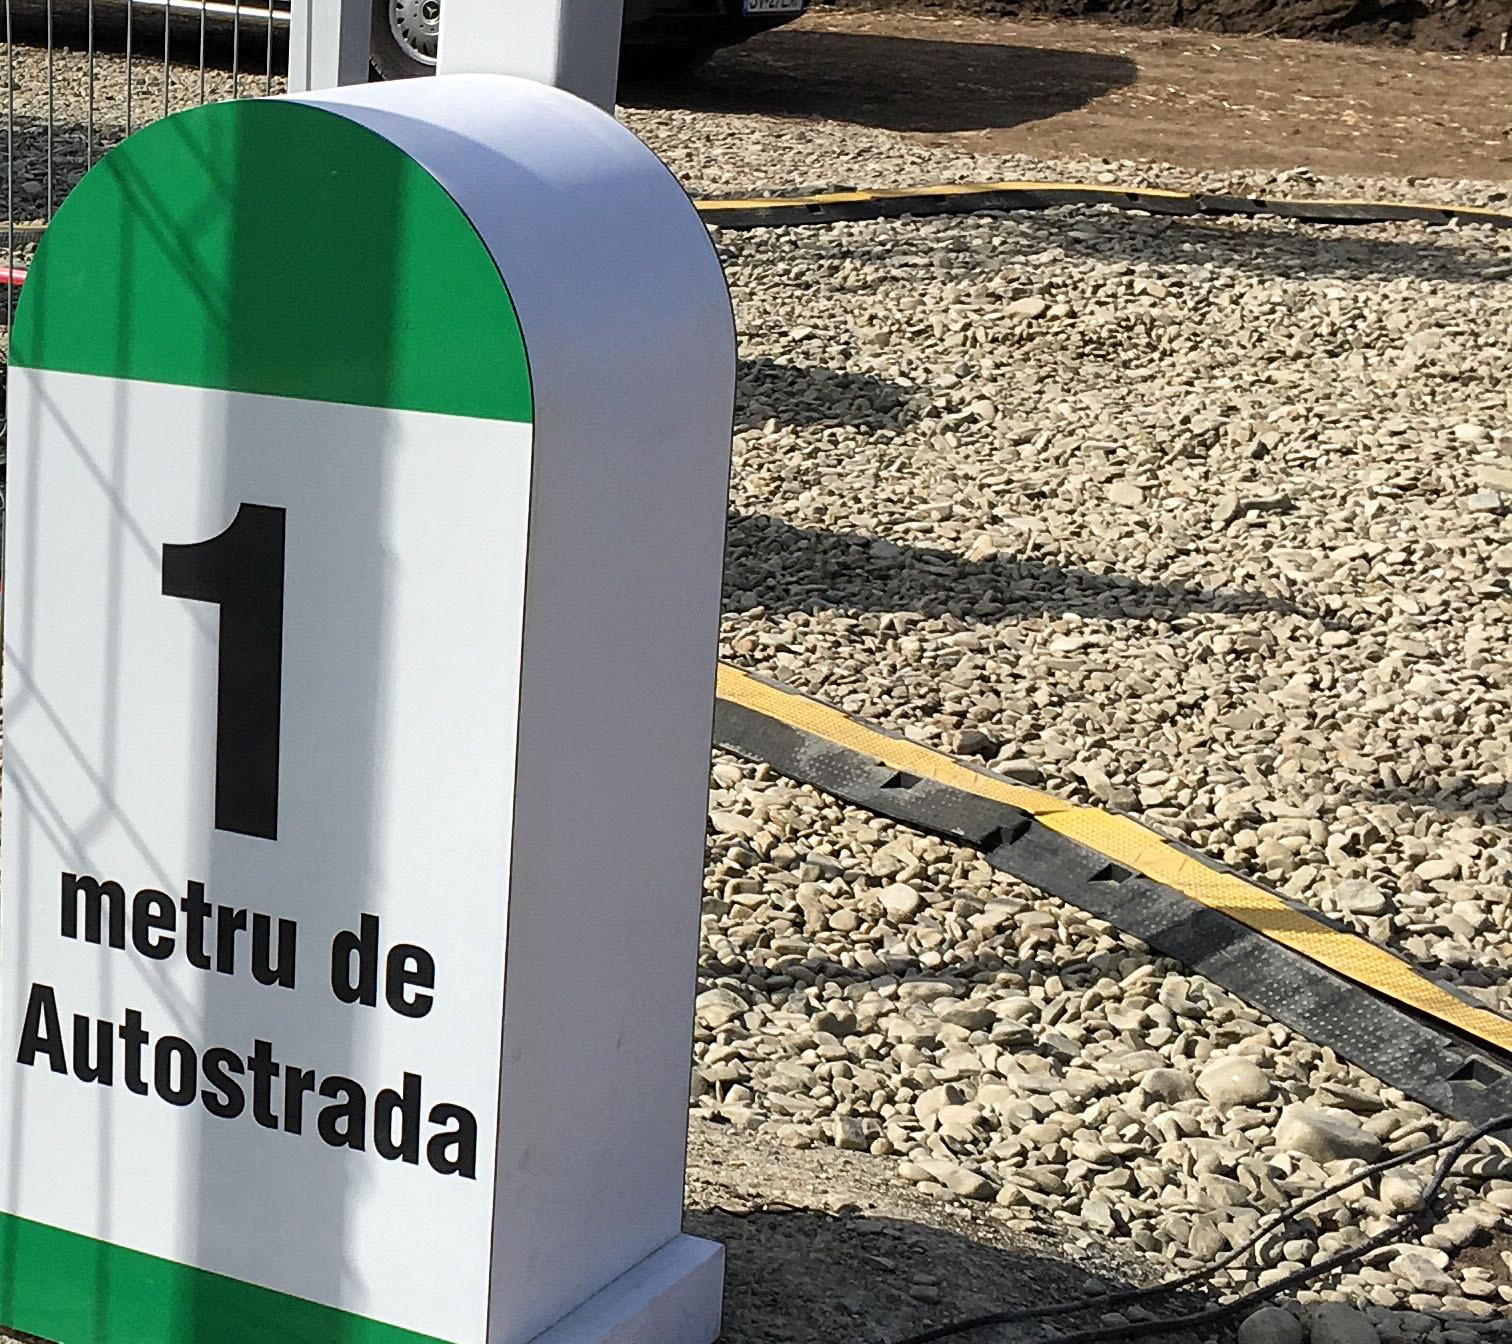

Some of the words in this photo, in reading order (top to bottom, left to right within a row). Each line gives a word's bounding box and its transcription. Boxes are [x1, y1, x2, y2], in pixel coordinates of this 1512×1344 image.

[162, 503, 286, 841] 1
[61, 871, 298, 990] metru
[330, 912, 436, 1019] de
[16, 982, 478, 1180] Autostrada
